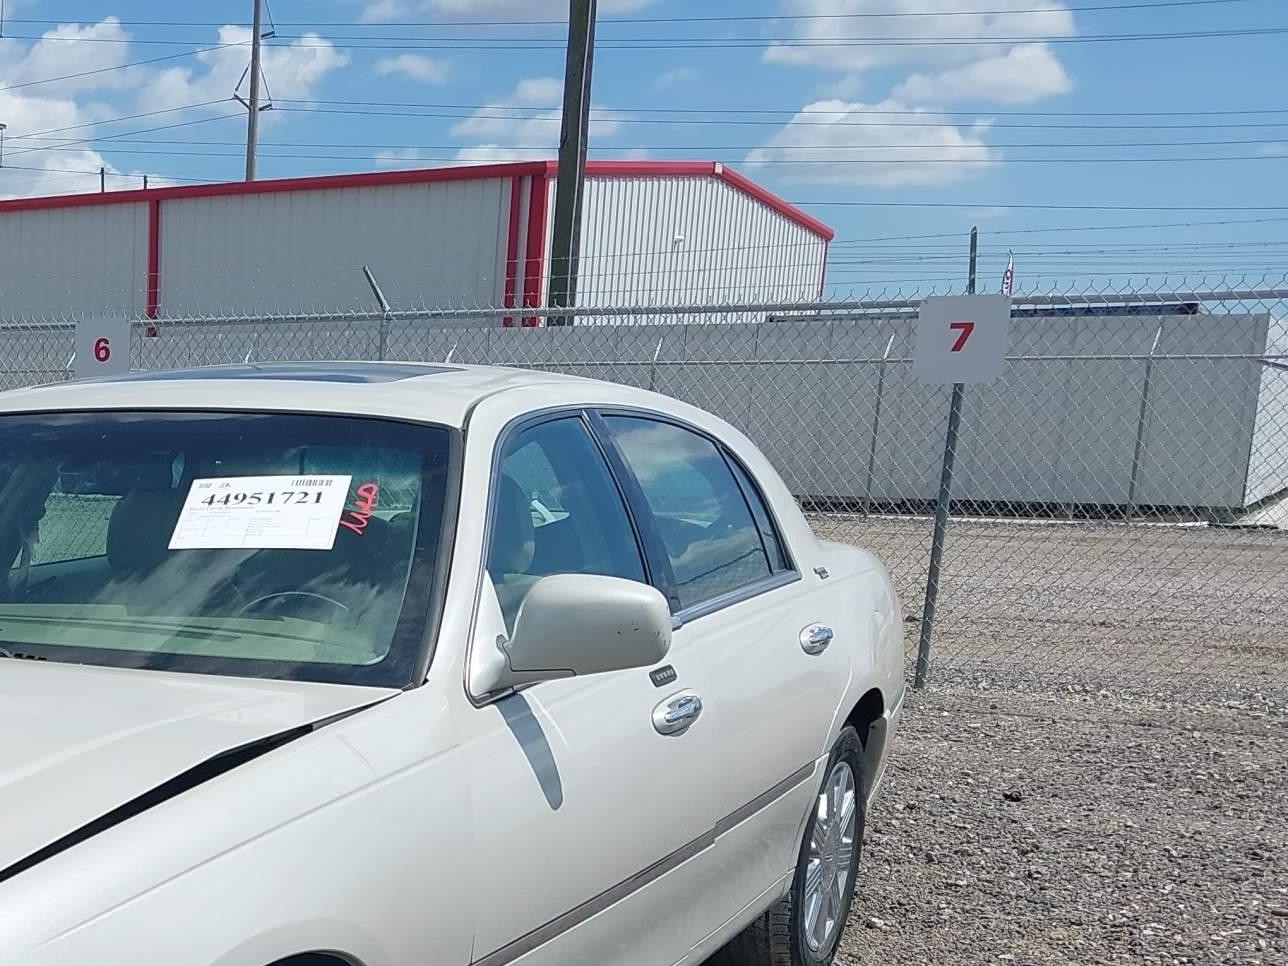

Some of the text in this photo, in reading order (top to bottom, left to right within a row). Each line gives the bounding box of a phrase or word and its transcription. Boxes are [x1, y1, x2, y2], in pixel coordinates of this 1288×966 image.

[94, 337, 111, 363] 6
[949, 322, 975, 352] 7
[200, 491, 324, 506] 44951721
